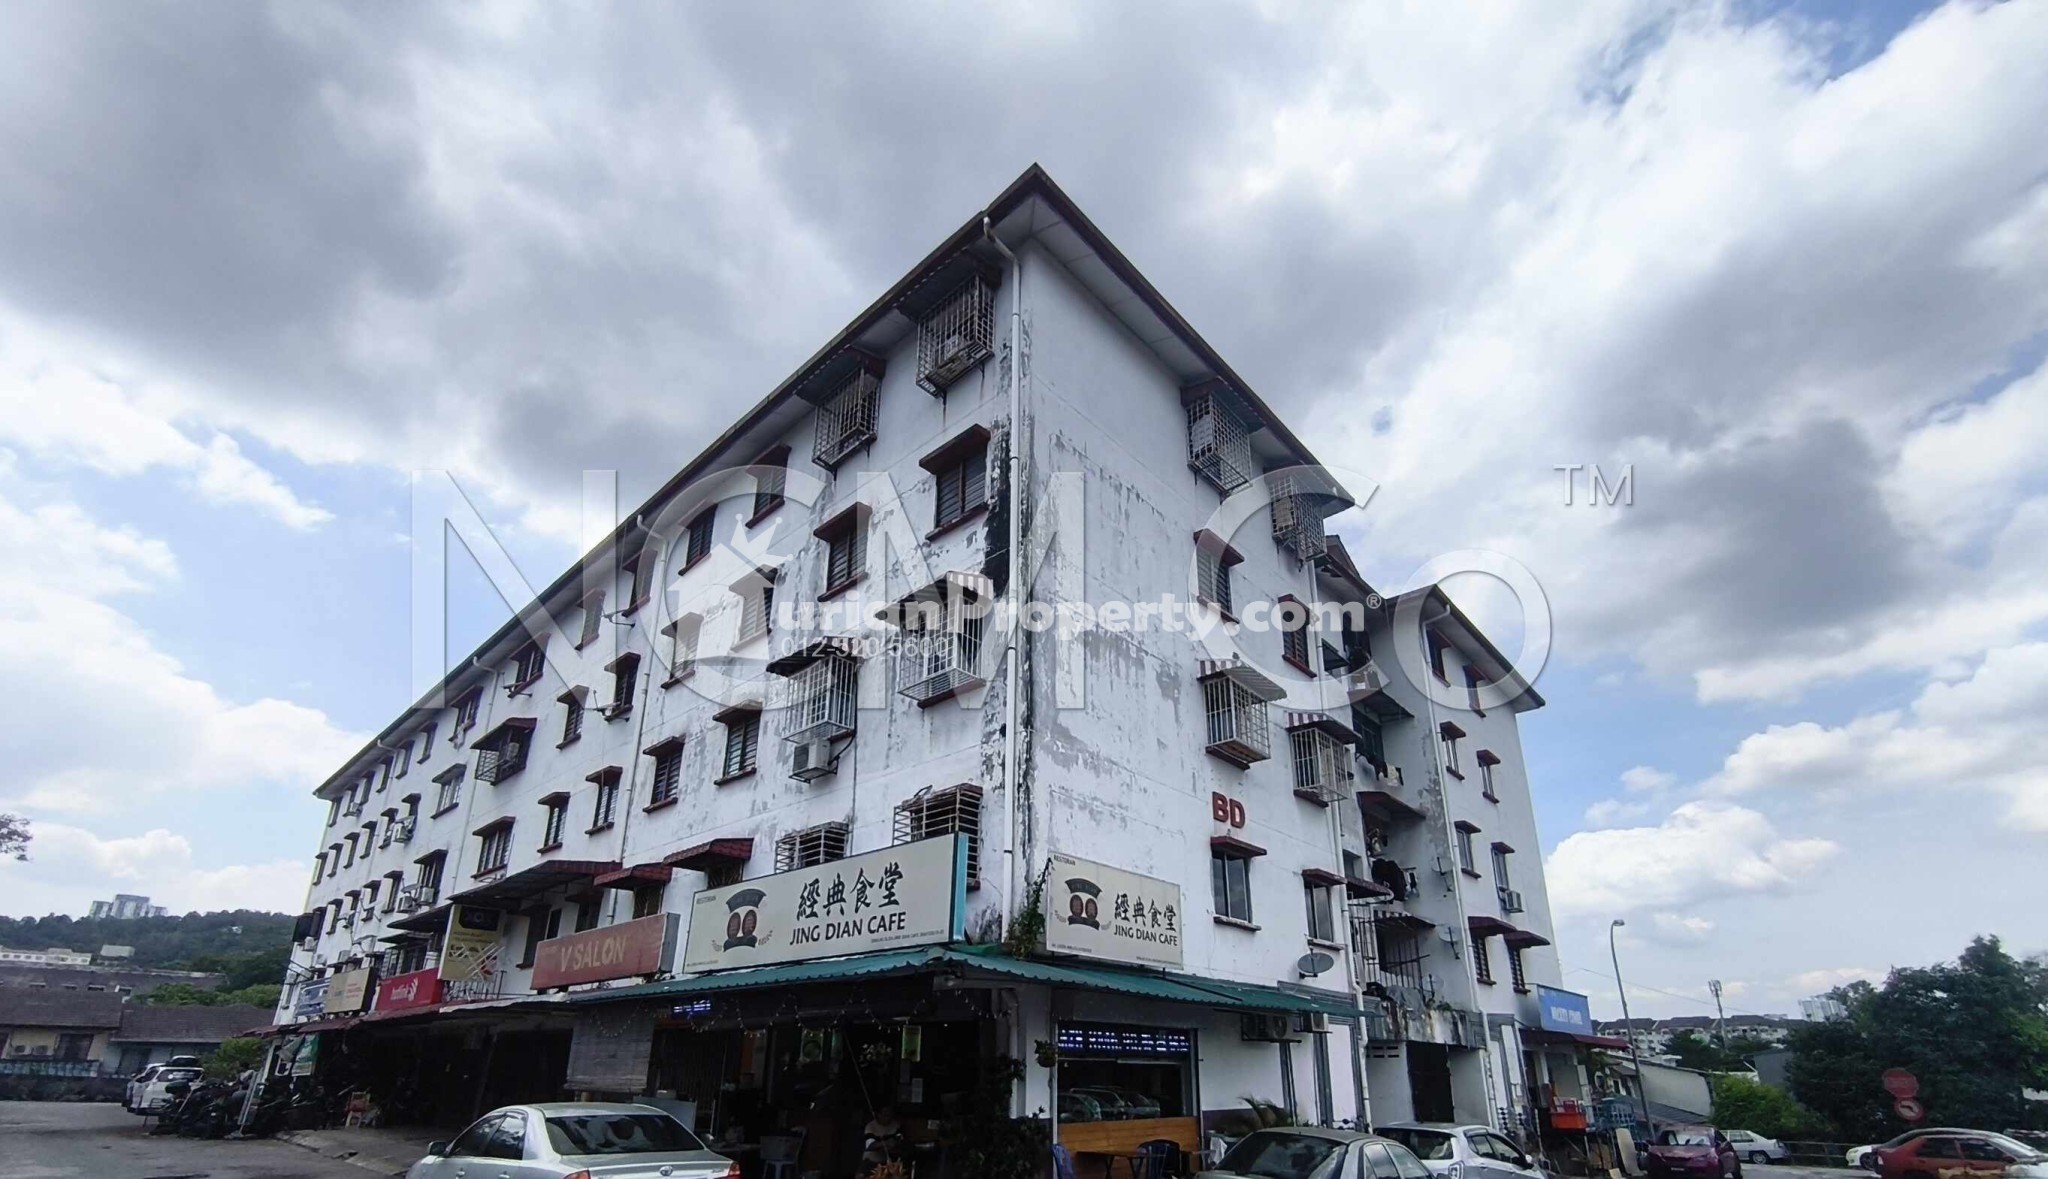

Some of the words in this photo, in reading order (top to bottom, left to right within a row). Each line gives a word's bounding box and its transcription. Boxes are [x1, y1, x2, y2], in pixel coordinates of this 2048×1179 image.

[1212, 791, 1246, 829] BD
[796, 861, 904, 921] 經典食堂
[789, 924, 821, 946] JING
[825, 918, 863, 940] DIAN
[867, 911, 907, 934] CAFE
[1114, 893, 1177, 933] 經典食堂
[572, 935, 627, 971] SALON
[1114, 924, 1134, 939] JING
[1136, 928, 1157, 943] DIAN
[1159, 933, 1178, 947] CAFE
